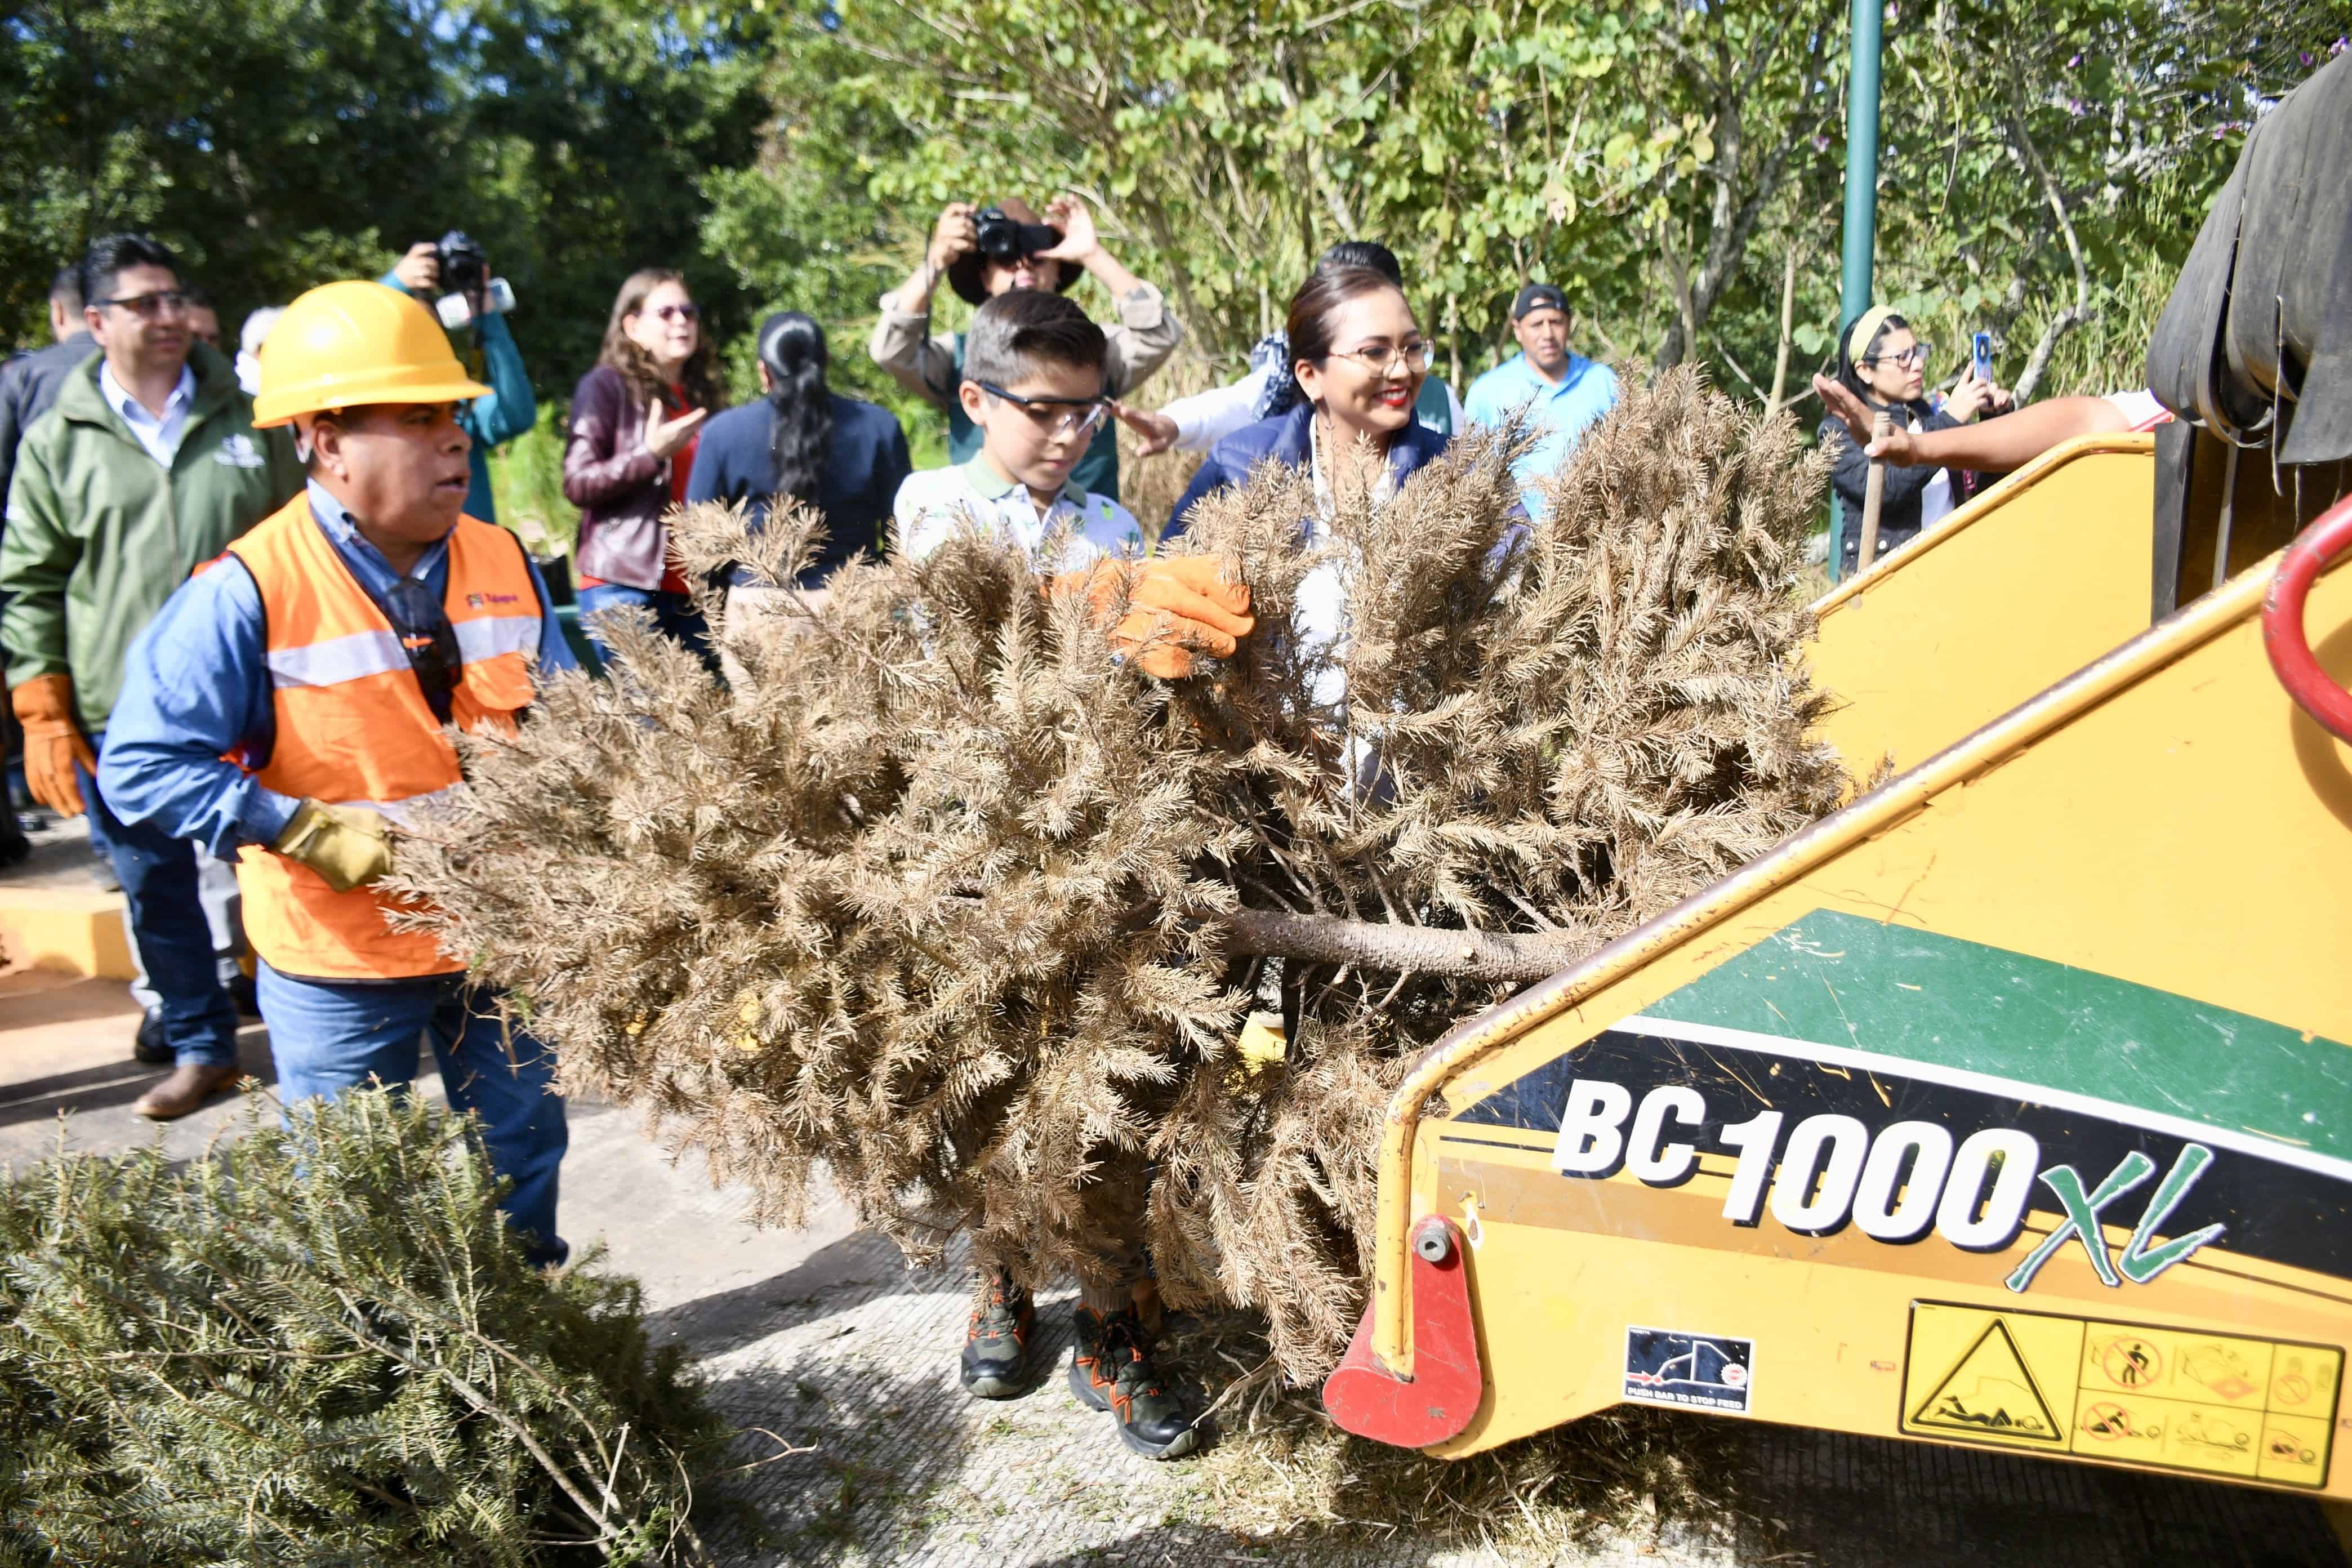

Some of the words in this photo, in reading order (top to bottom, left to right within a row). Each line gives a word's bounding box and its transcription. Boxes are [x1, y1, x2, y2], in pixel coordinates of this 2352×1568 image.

[1551, 1079, 1707, 1184] BC
[1720, 1111, 2041, 1249] 1000
[2004, 1143, 2226, 1293] XL
[1628, 1387, 1653, 1397] PUSH
[1655, 1390, 1674, 1401] BAR
[1676, 1393, 1689, 1403] TO
[1690, 1396, 1716, 1406] STOP
[1717, 1399, 1743, 1409] FEED
